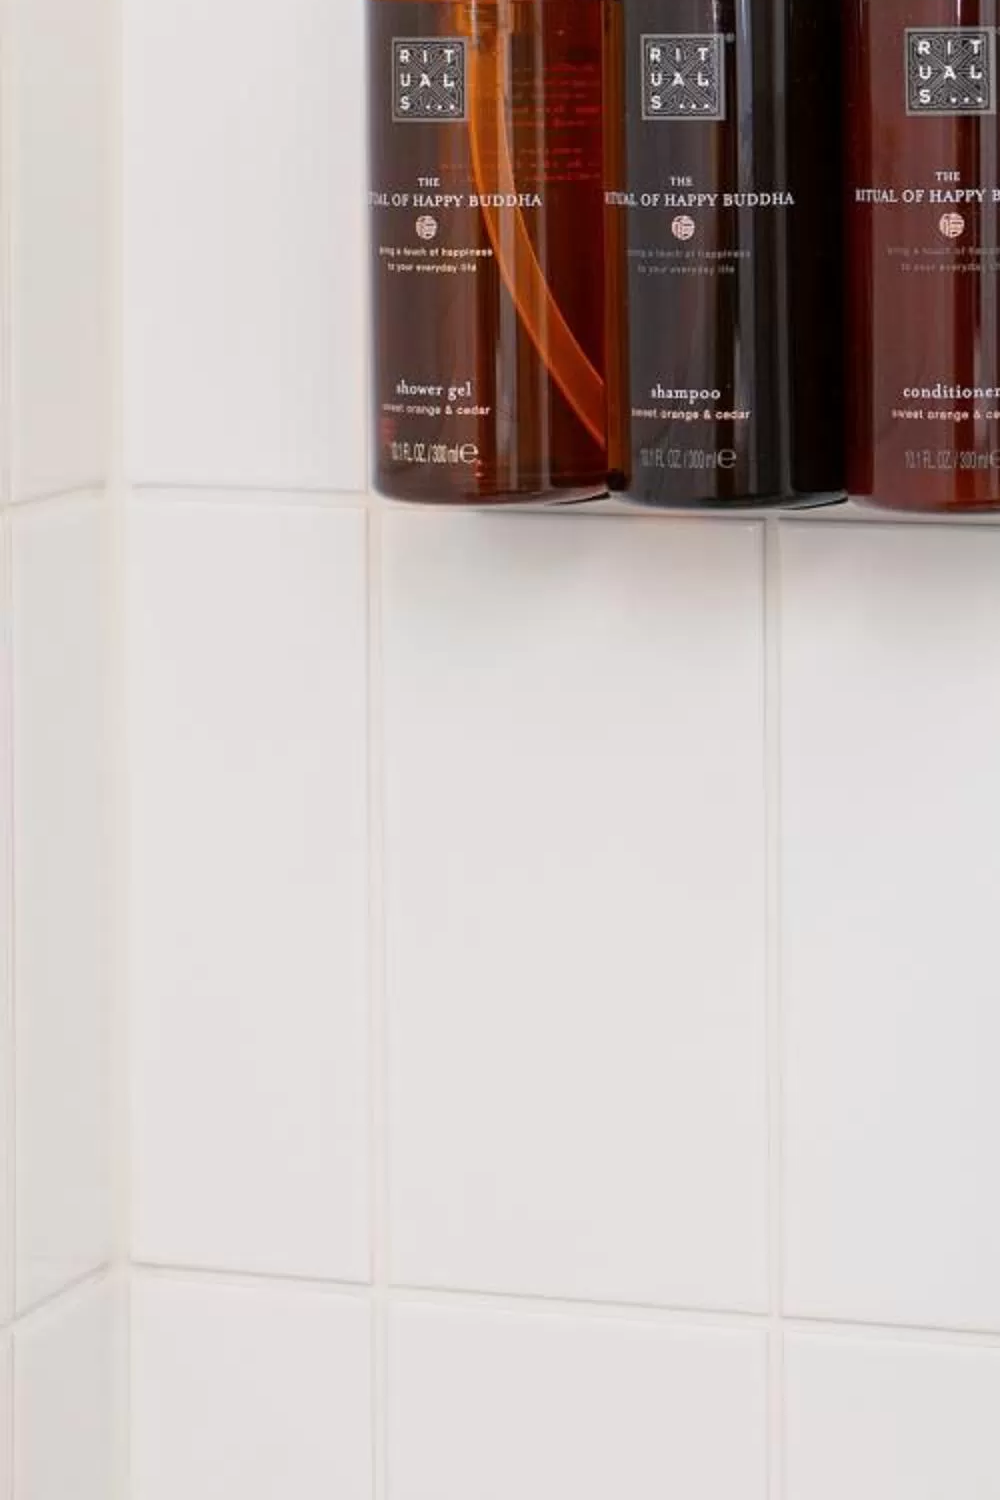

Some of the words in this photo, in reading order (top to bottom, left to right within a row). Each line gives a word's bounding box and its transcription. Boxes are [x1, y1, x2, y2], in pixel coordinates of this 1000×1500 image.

[417, 177, 441, 187] THE
[670, 176, 693, 186] THE
[935, 171, 960, 181] THE
[392, 194, 408, 206] OF
[413, 193, 463, 207] HAPPY
[469, 193, 542, 207] BUDDHA
[641, 193, 661, 207] OF
[663, 193, 718, 207] HAPPY
[723, 192, 795, 206] BUDDHA
[855, 188, 898, 203] RITUAL
[902, 189, 925, 203] OF
[929, 189, 986, 203] HAPPY
[441, 248, 493, 258] happiness
[416, 264, 457, 273] everyday
[396, 379, 444, 396] shower
[448, 381, 472, 401] gel
[651, 383, 721, 404] shampoo
[406, 405, 442, 417] orange
[445, 405, 453, 415] &
[456, 405, 491, 416] cedar
[660, 410, 698, 421] orange
[703, 409, 711, 419] &
[715, 409, 751, 419] cedar
[891, 409, 923, 419] sweet
[926, 410, 969, 422] orange
[973, 409, 981, 419] &
